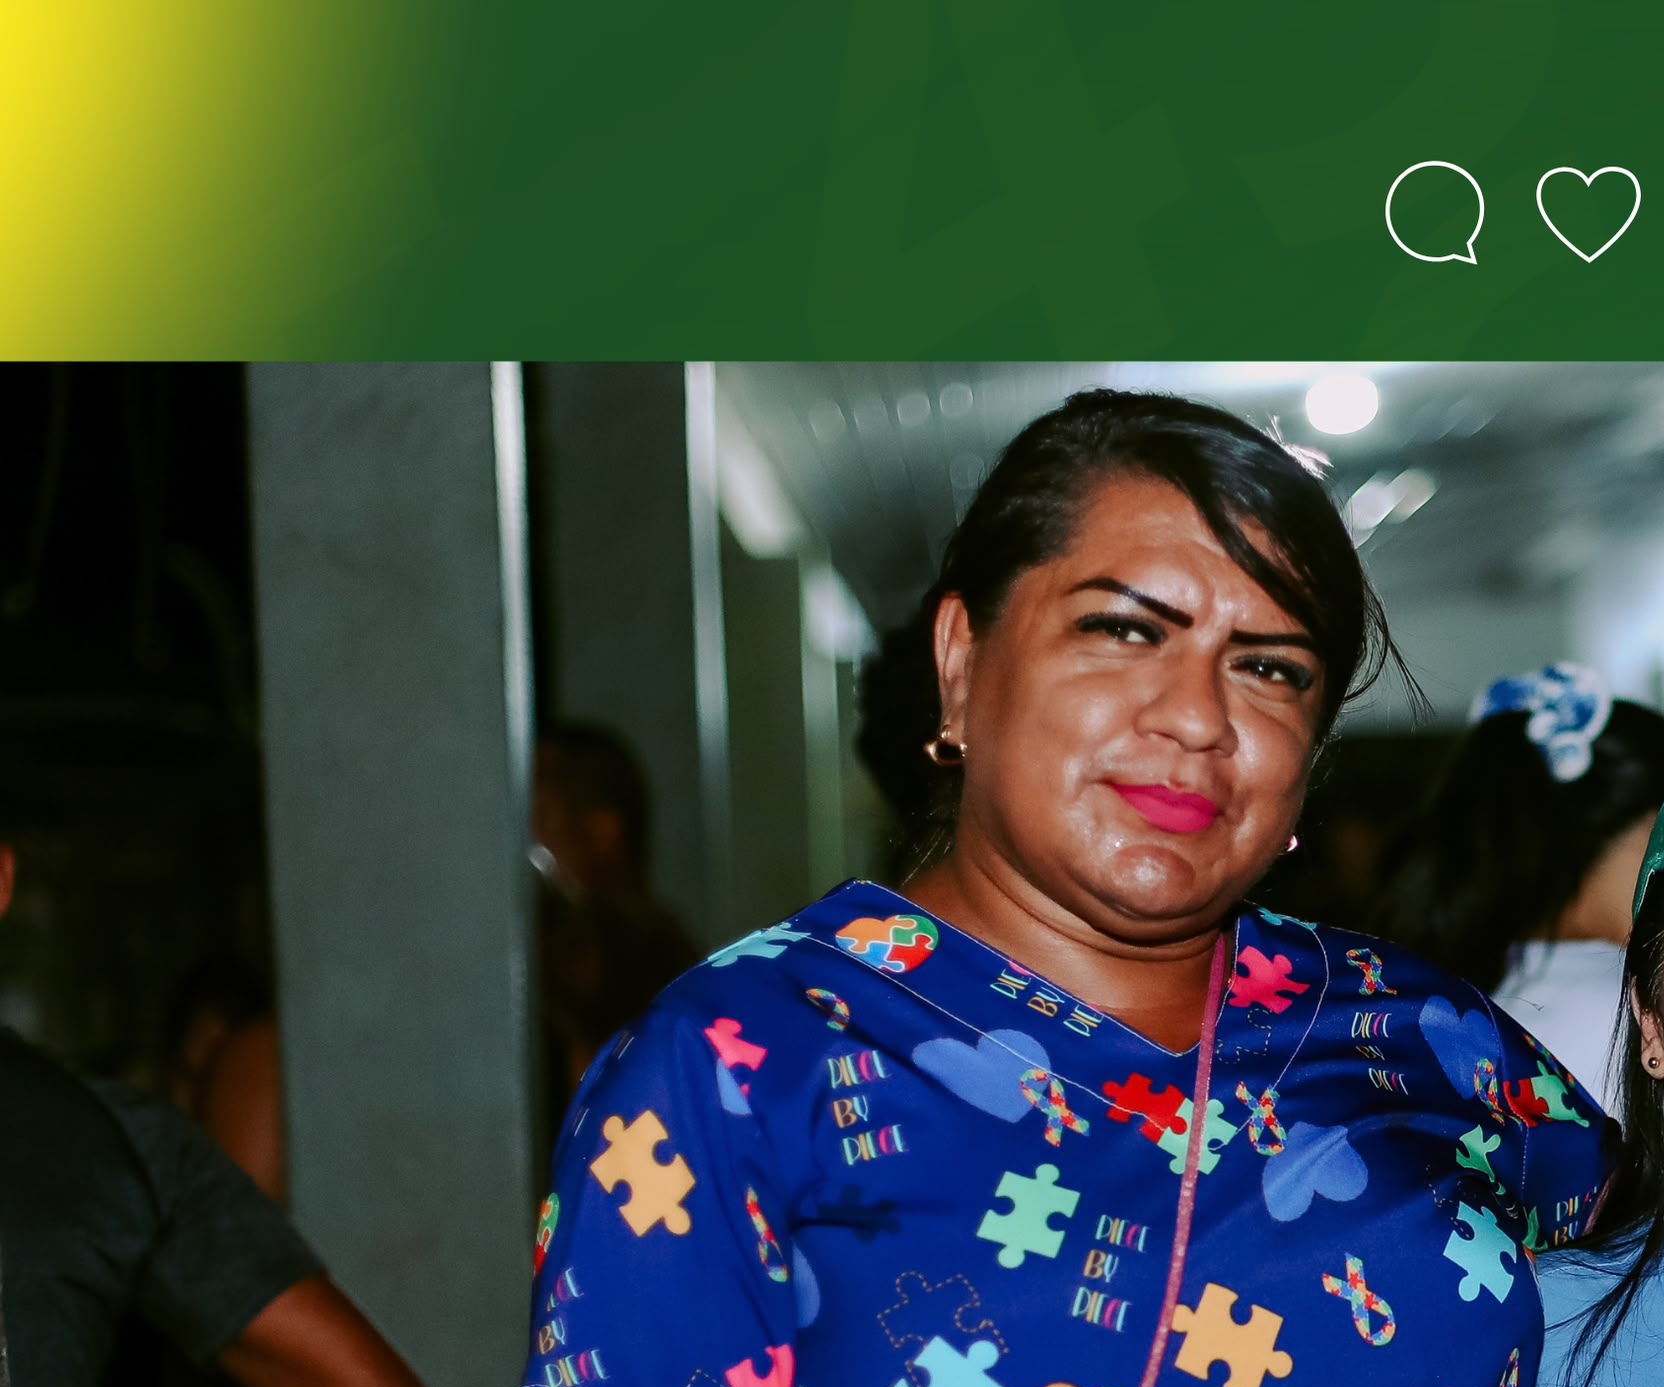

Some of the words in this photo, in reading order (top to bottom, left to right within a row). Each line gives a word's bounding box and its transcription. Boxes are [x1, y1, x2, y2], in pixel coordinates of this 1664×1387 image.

[1026, 986, 1065, 1017] BY
[827, 1049, 893, 1089] PIECE
[832, 1094, 869, 1129] BY
[842, 1124, 911, 1166] PIECE
[1095, 1214, 1152, 1254] PIECE
[1083, 1248, 1120, 1283] BY
[1071, 1286, 1134, 1333] PIECE
[538, 1316, 566, 1355] BY
